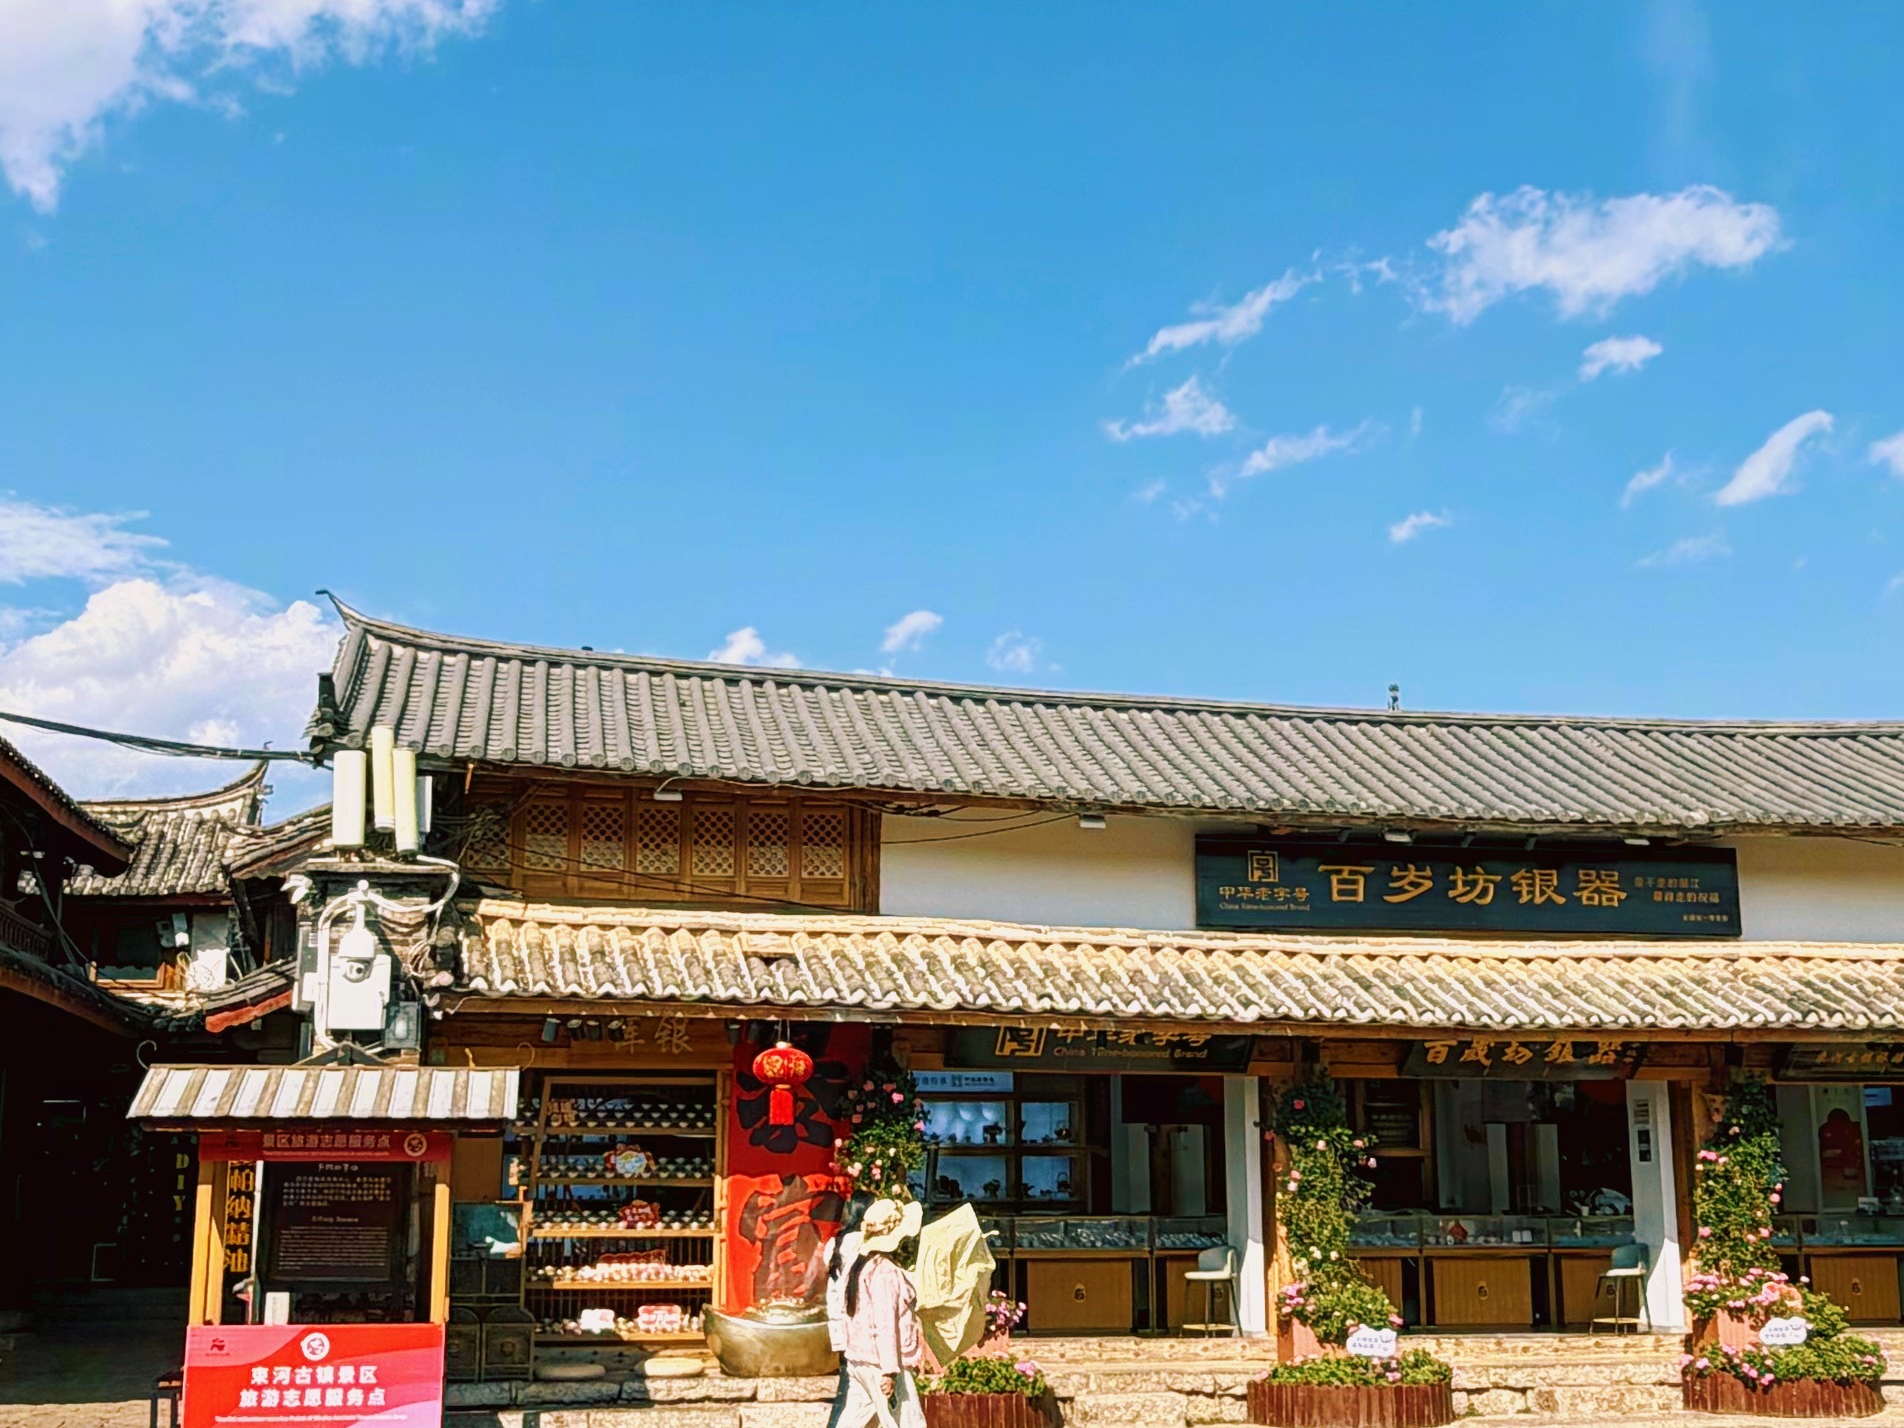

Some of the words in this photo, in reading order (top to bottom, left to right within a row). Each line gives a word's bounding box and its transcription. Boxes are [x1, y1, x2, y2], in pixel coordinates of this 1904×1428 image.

[1219, 886, 1310, 903] 中华老字号
[1318, 864, 1627, 908] 百岁坊银器
[263, 1133, 392, 1149] 景区旅游志愿服务点
[250, 1365, 378, 1386] 束河古镇景区
[238, 1387, 387, 1408] 旅游志愿服务点
